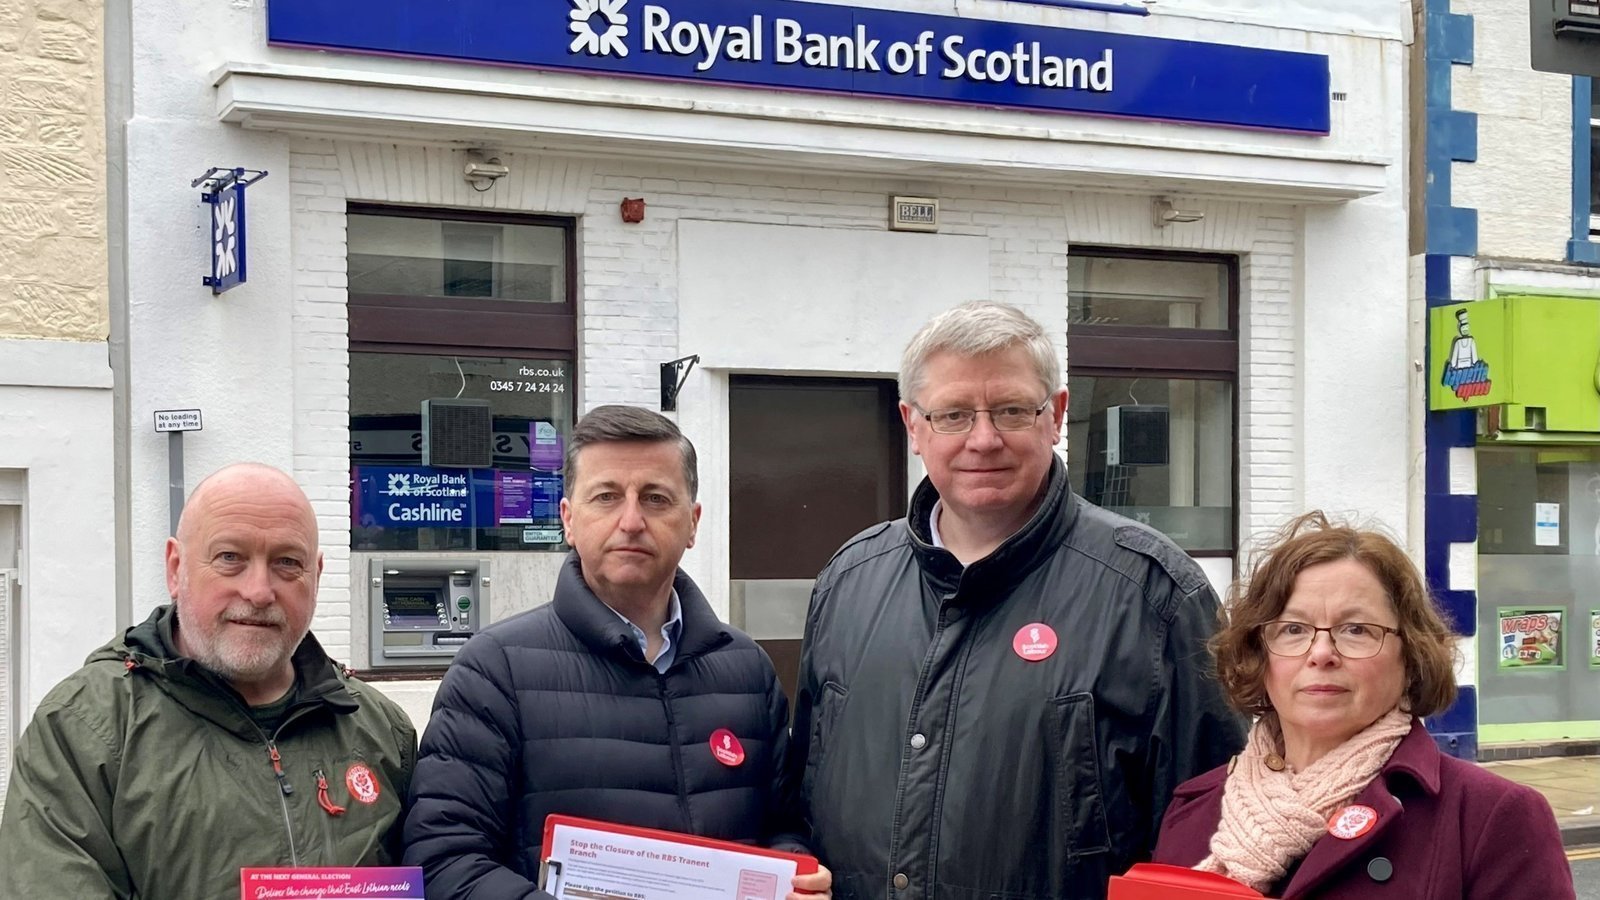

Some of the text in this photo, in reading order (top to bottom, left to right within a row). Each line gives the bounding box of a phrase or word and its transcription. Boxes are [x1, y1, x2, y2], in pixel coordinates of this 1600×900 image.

[643, 5, 1113, 92] Royal Bank of Scotland
[901, 205, 932, 217] BELL
[519, 366, 565, 377] rbs.co.uk
[490, 381, 565, 393] 0345 7 24 24 24
[171, 413, 198, 421] loading
[413, 474, 466, 486] Royal Bank
[413, 487, 467, 497] of Scotland
[388, 502, 462, 521] Cashline
[1502, 615, 1548, 635] wraps
[569, 848, 597, 858] Branch
[571, 840, 588, 849] Stop
[590, 842, 603, 850] the
[605, 845, 635, 855] Closure
[647, 852, 660, 860] the
[662, 854, 677, 862] RBS
[679, 857, 710, 868] Tranent
[255, 881, 411, 900] Deliver the change that East Lothian needs
[564, 881, 582, 889] Please
[583, 884, 594, 892] sign
